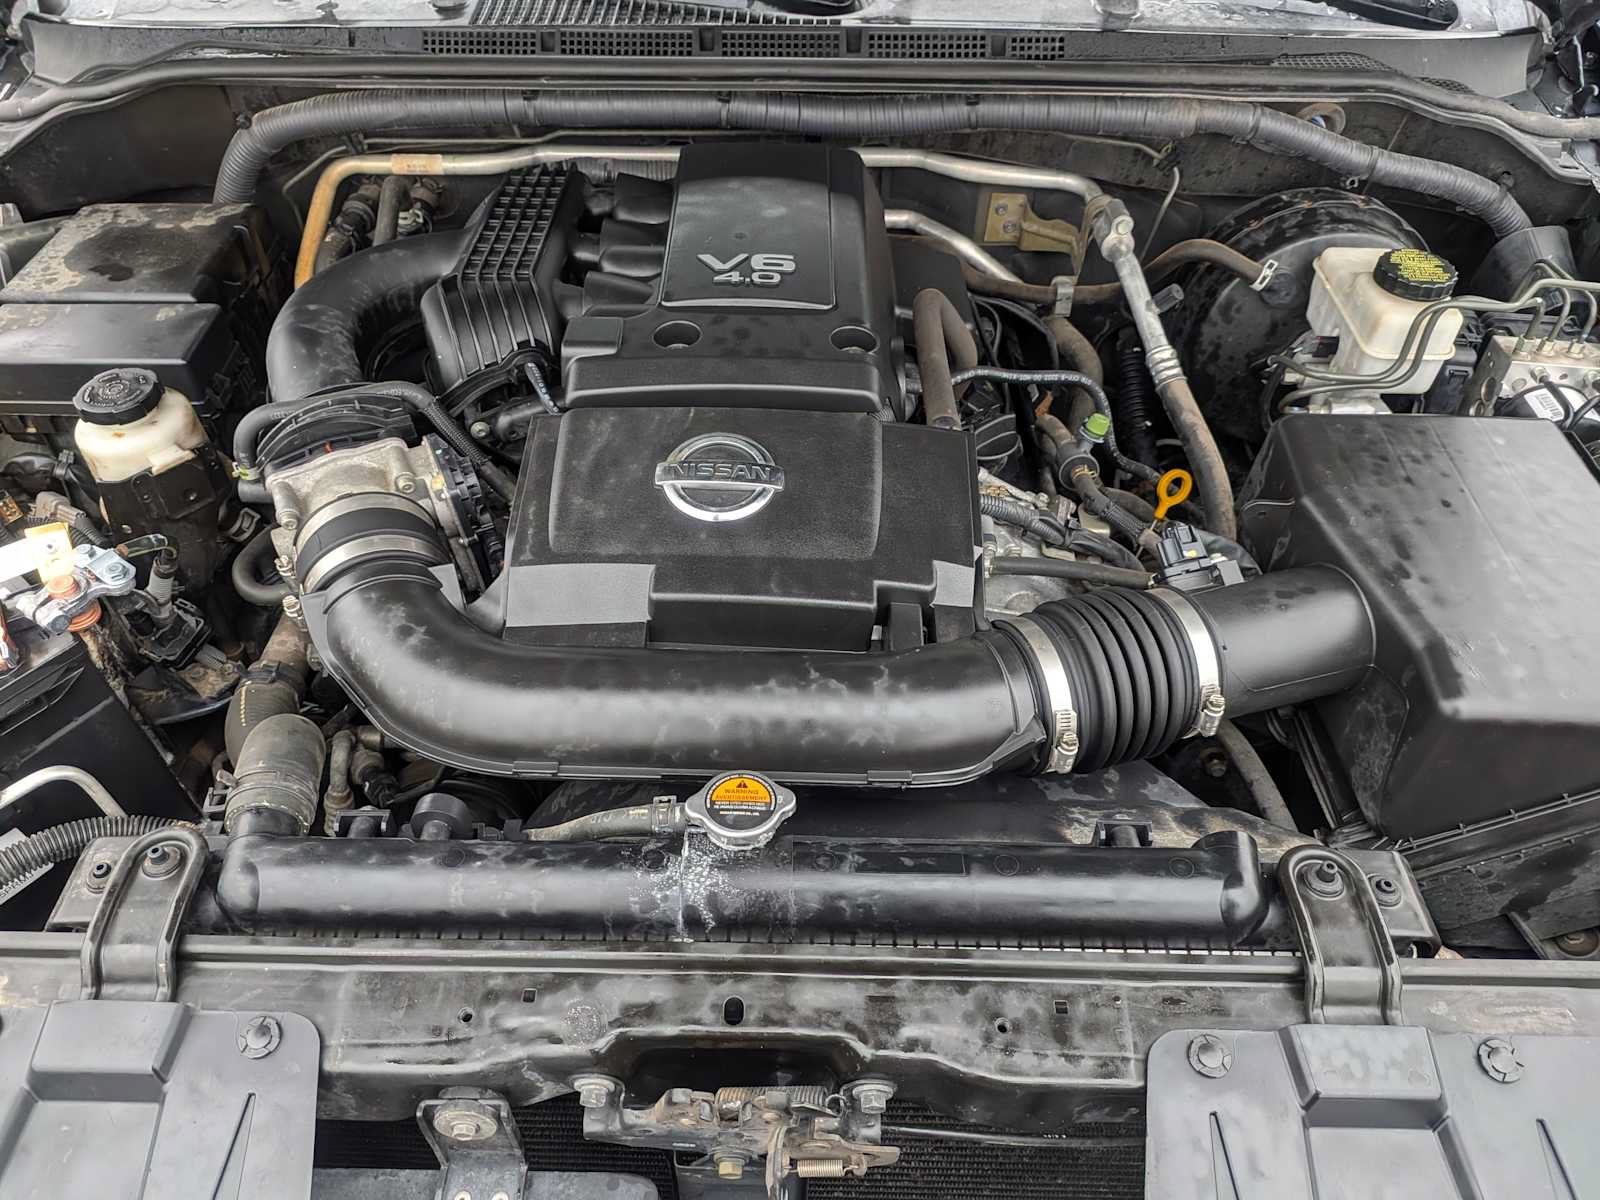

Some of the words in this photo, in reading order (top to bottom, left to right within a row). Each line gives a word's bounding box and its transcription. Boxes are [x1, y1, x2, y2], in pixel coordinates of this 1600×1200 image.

[697, 253, 796, 272] V6
[713, 271, 781, 285] 4.0
[670, 463, 771, 480] NISSAN
